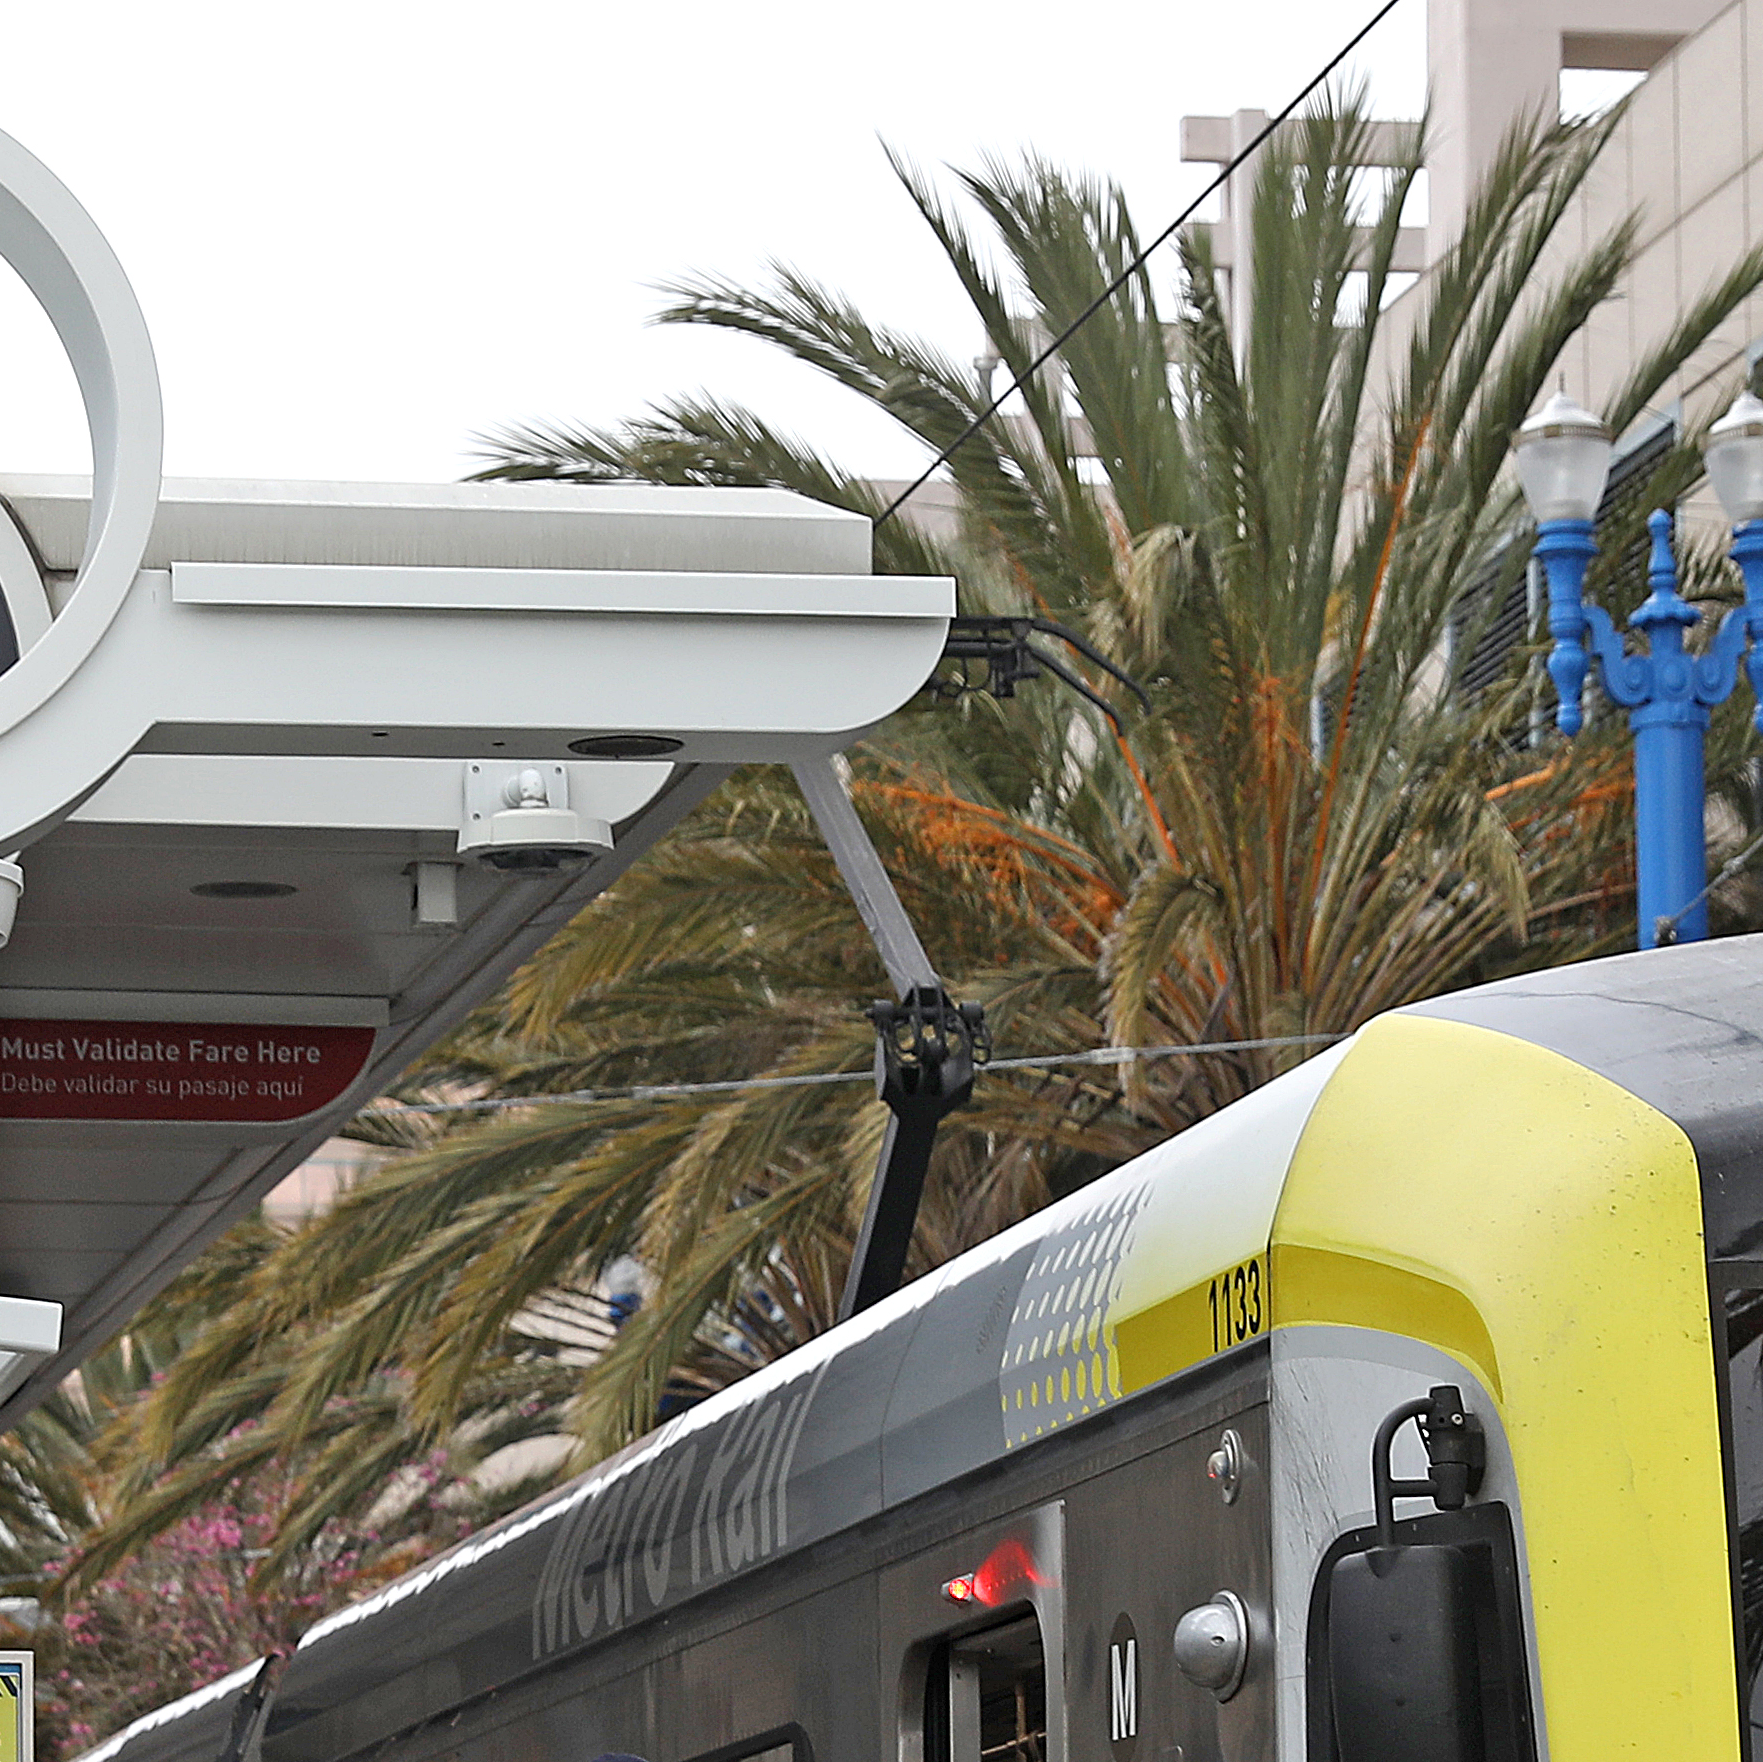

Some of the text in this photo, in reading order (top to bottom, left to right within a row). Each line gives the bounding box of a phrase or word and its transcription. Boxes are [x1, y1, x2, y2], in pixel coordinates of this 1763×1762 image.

[1, 1036, 322, 1064] Must Validate Fare Here
[1, 1072, 56, 1093] Debe
[64, 1073, 138, 1095] validar
[146, 1079, 171, 1095] su
[179, 1078, 250, 1101] pasaje
[1208, 1260, 1262, 1353] 1133
[532, 1360, 828, 1660] Metro Rail
[1111, 1638, 1137, 1742] M
